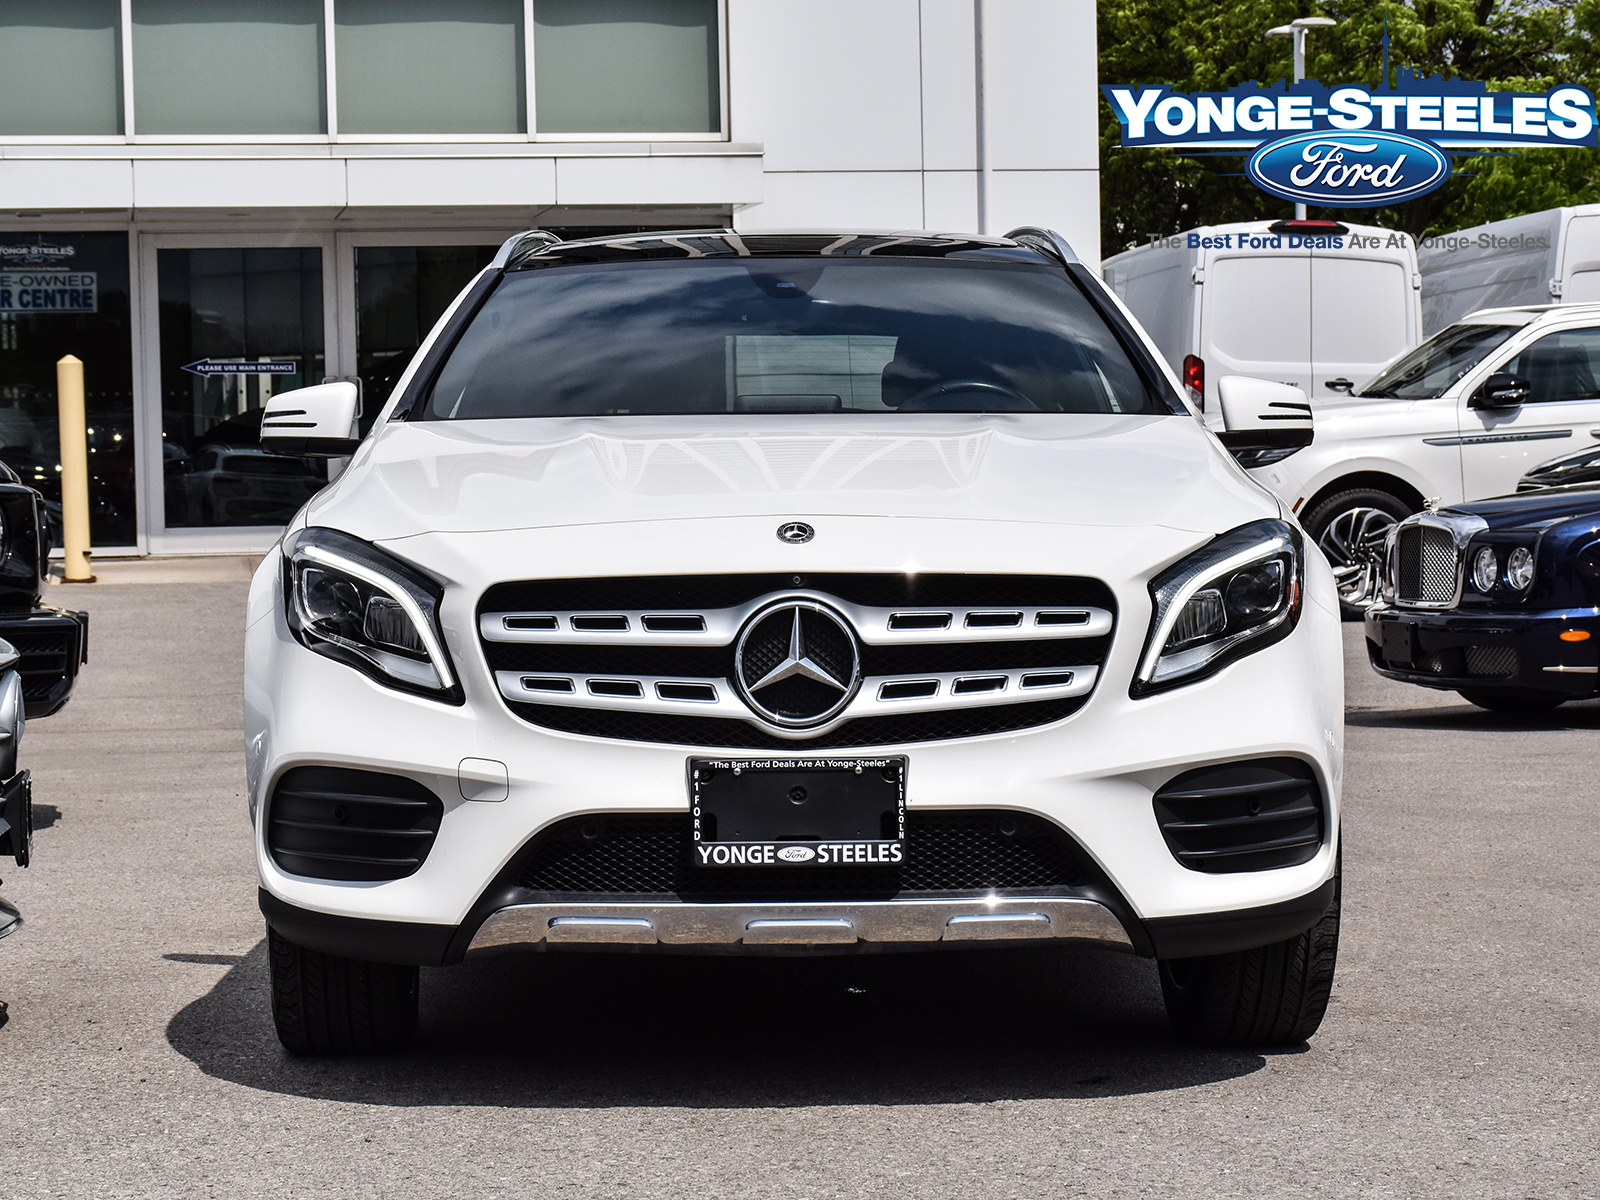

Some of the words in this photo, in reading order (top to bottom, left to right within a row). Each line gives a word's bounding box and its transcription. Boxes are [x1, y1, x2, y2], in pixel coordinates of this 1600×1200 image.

[0, 275, 95, 287] E-OWNED
[18, 288, 94, 308] CENTRE
[751, 760, 771, 768] Ford
[772, 760, 795, 768] Deals
[797, 760, 813, 768] Are
[814, 760, 826, 768] At
[697, 845, 775, 864] YONGE
[784, 849, 808, 859] Ford
[817, 843, 903, 863] STEELES
